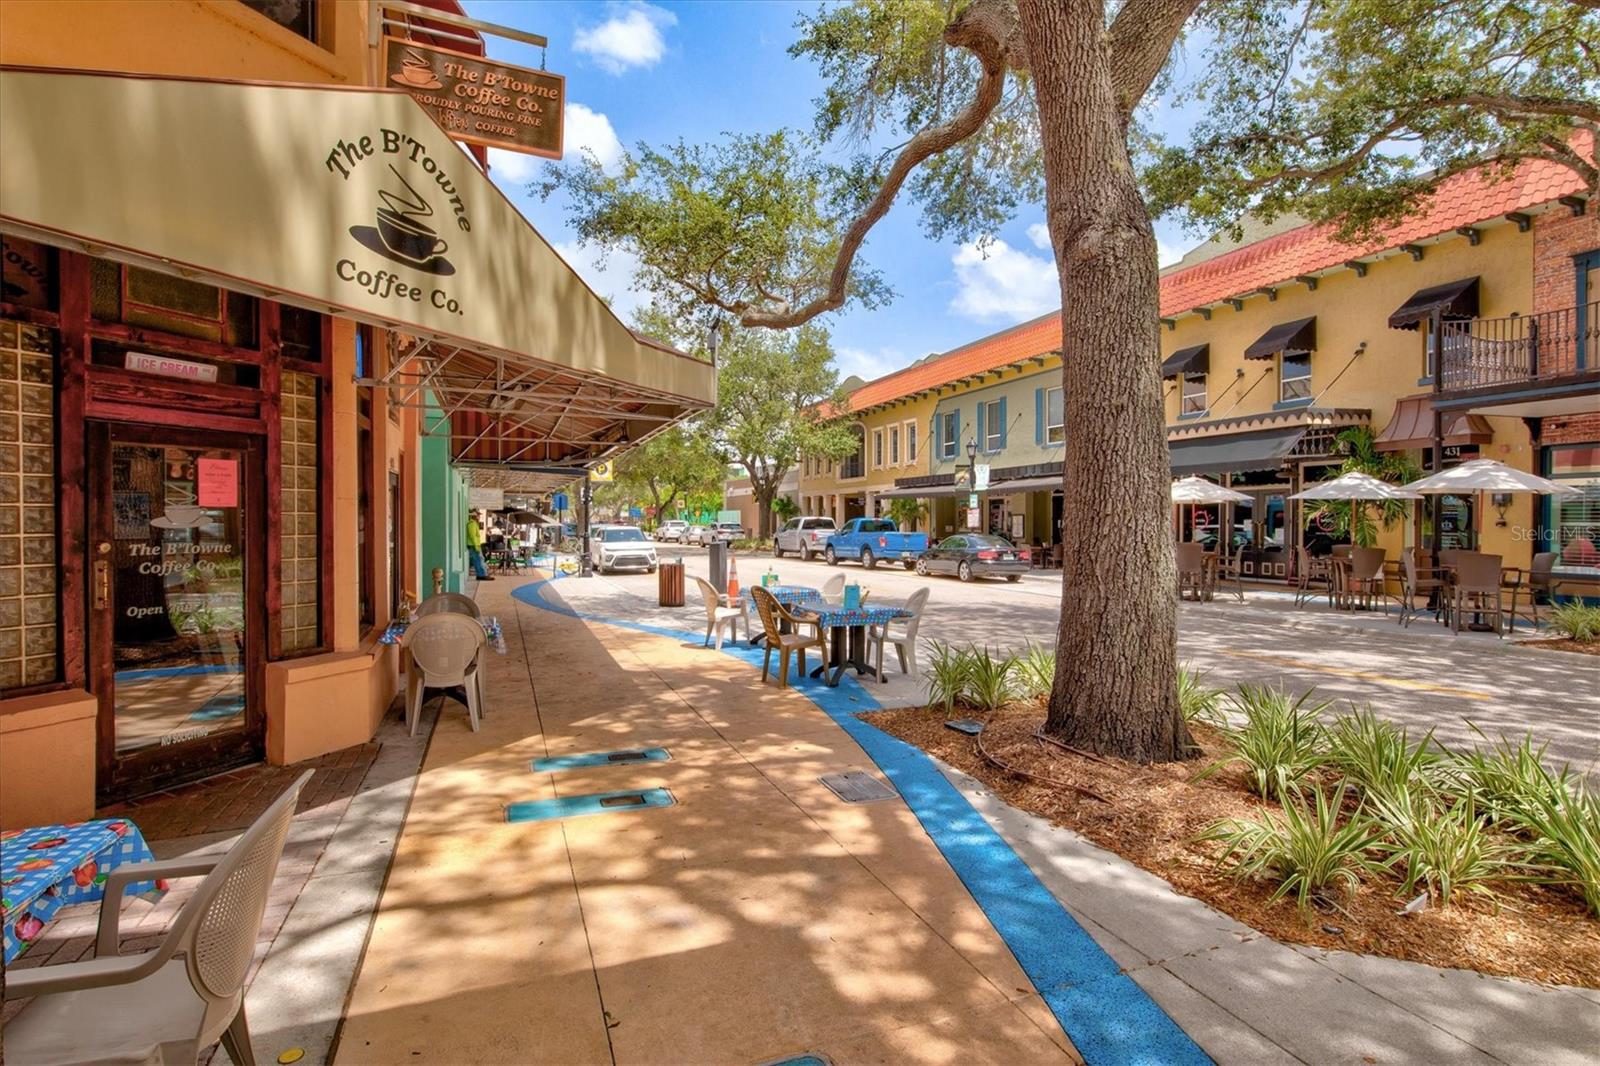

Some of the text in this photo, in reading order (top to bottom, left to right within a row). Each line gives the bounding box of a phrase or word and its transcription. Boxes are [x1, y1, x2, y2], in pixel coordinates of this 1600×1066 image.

[444, 62, 558, 99] The B'Towne
[454, 84, 543, 113] Coffee Co.
[415, 93, 542, 127] ROUDLY POURING FINE
[475, 121, 518, 137] COFFEE
[325, 128, 472, 233] The B'Towne
[336, 259, 464, 316] Coffee Co.
[137, 358, 156, 369] ICE
[160, 361, 199, 377] CREAM
[1445, 447, 1461, 457] 431
[129, 543, 232, 556] The B'Towne
[140, 561, 191, 576] Coffee
[126, 606, 164, 619] Open
